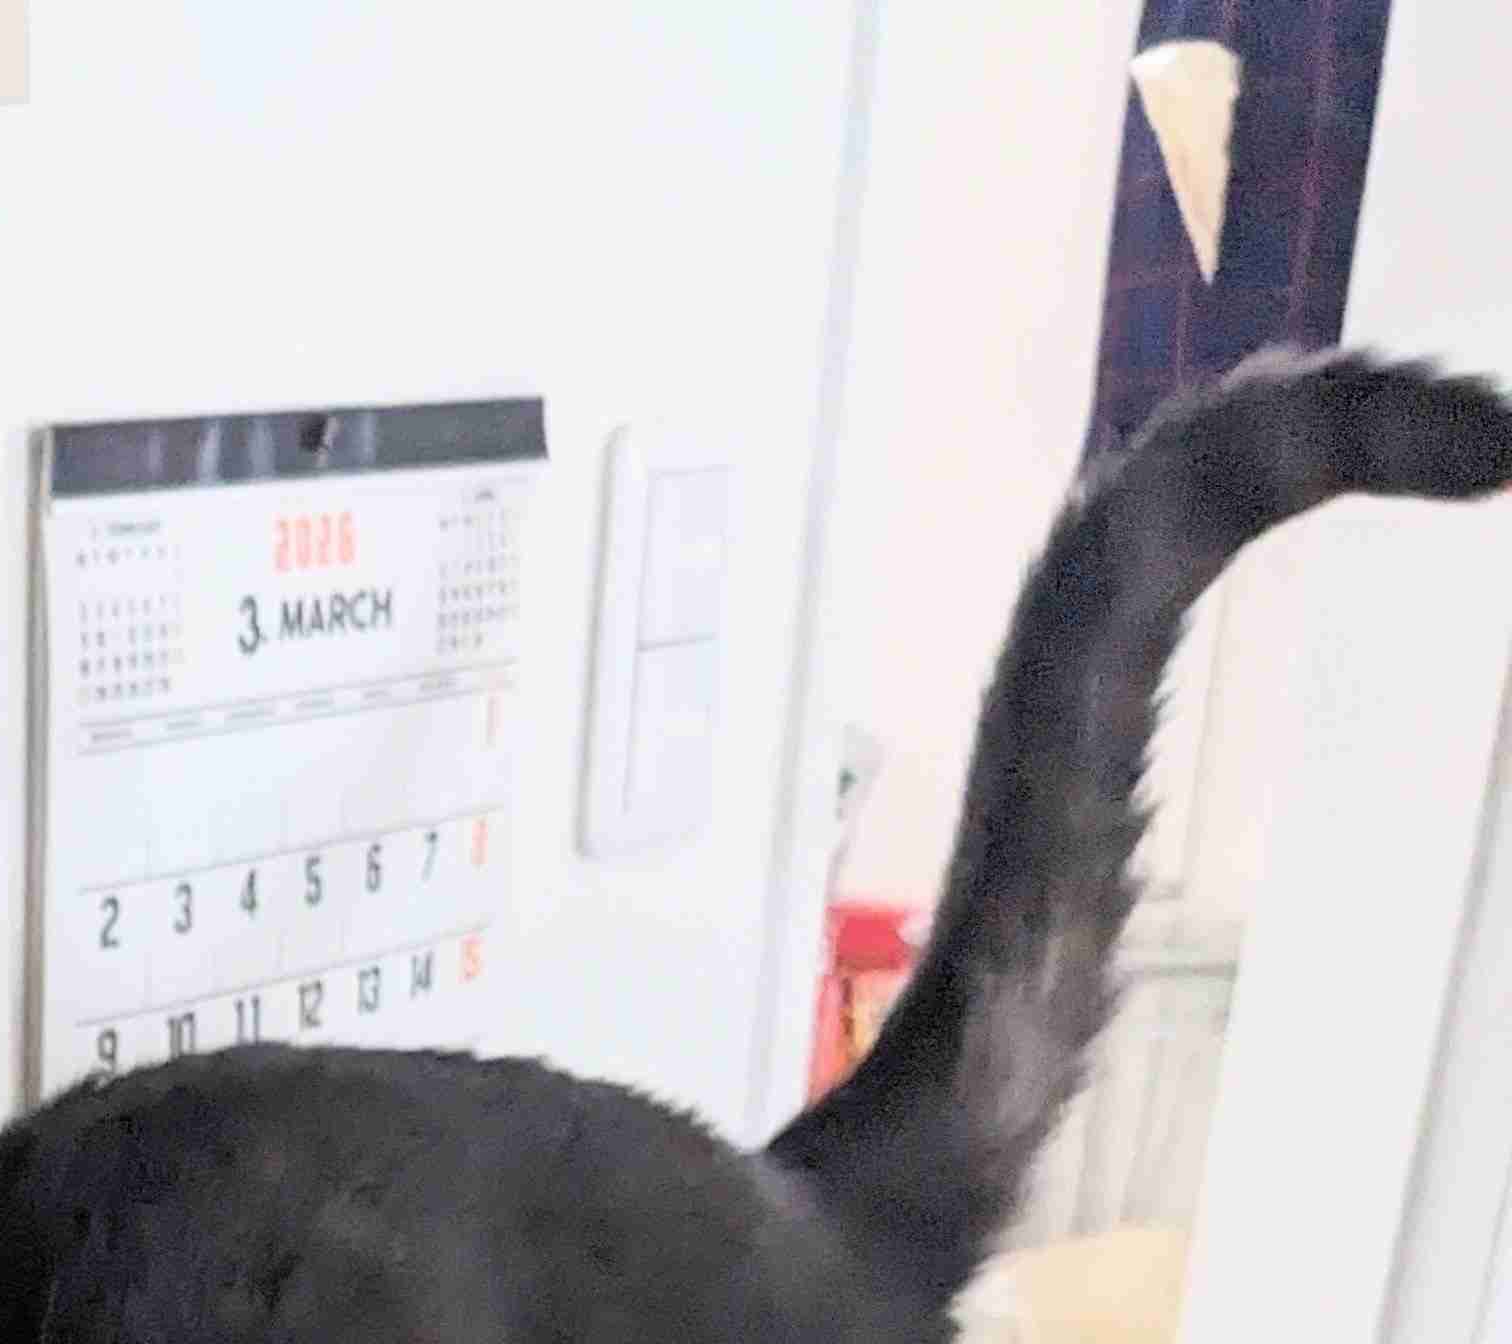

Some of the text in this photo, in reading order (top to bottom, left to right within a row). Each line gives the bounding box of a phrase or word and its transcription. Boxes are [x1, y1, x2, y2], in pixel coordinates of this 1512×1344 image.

[273, 512, 355, 572] 2026
[280, 587, 392, 640] MARCH
[99, 895, 120, 949] 2
[173, 883, 193, 935] 3
[240, 868, 258, 918] 4
[304, 855, 322, 906] 5
[365, 843, 382, 893] 6
[422, 830, 438, 883] 7
[97, 1026, 119, 1085] 9
[168, 1010, 196, 1060] 10
[235, 994, 261, 1047] 11
[298, 979, 323, 1030] 12
[358, 965, 381, 1015] 13
[410, 950, 436, 1000] 14
